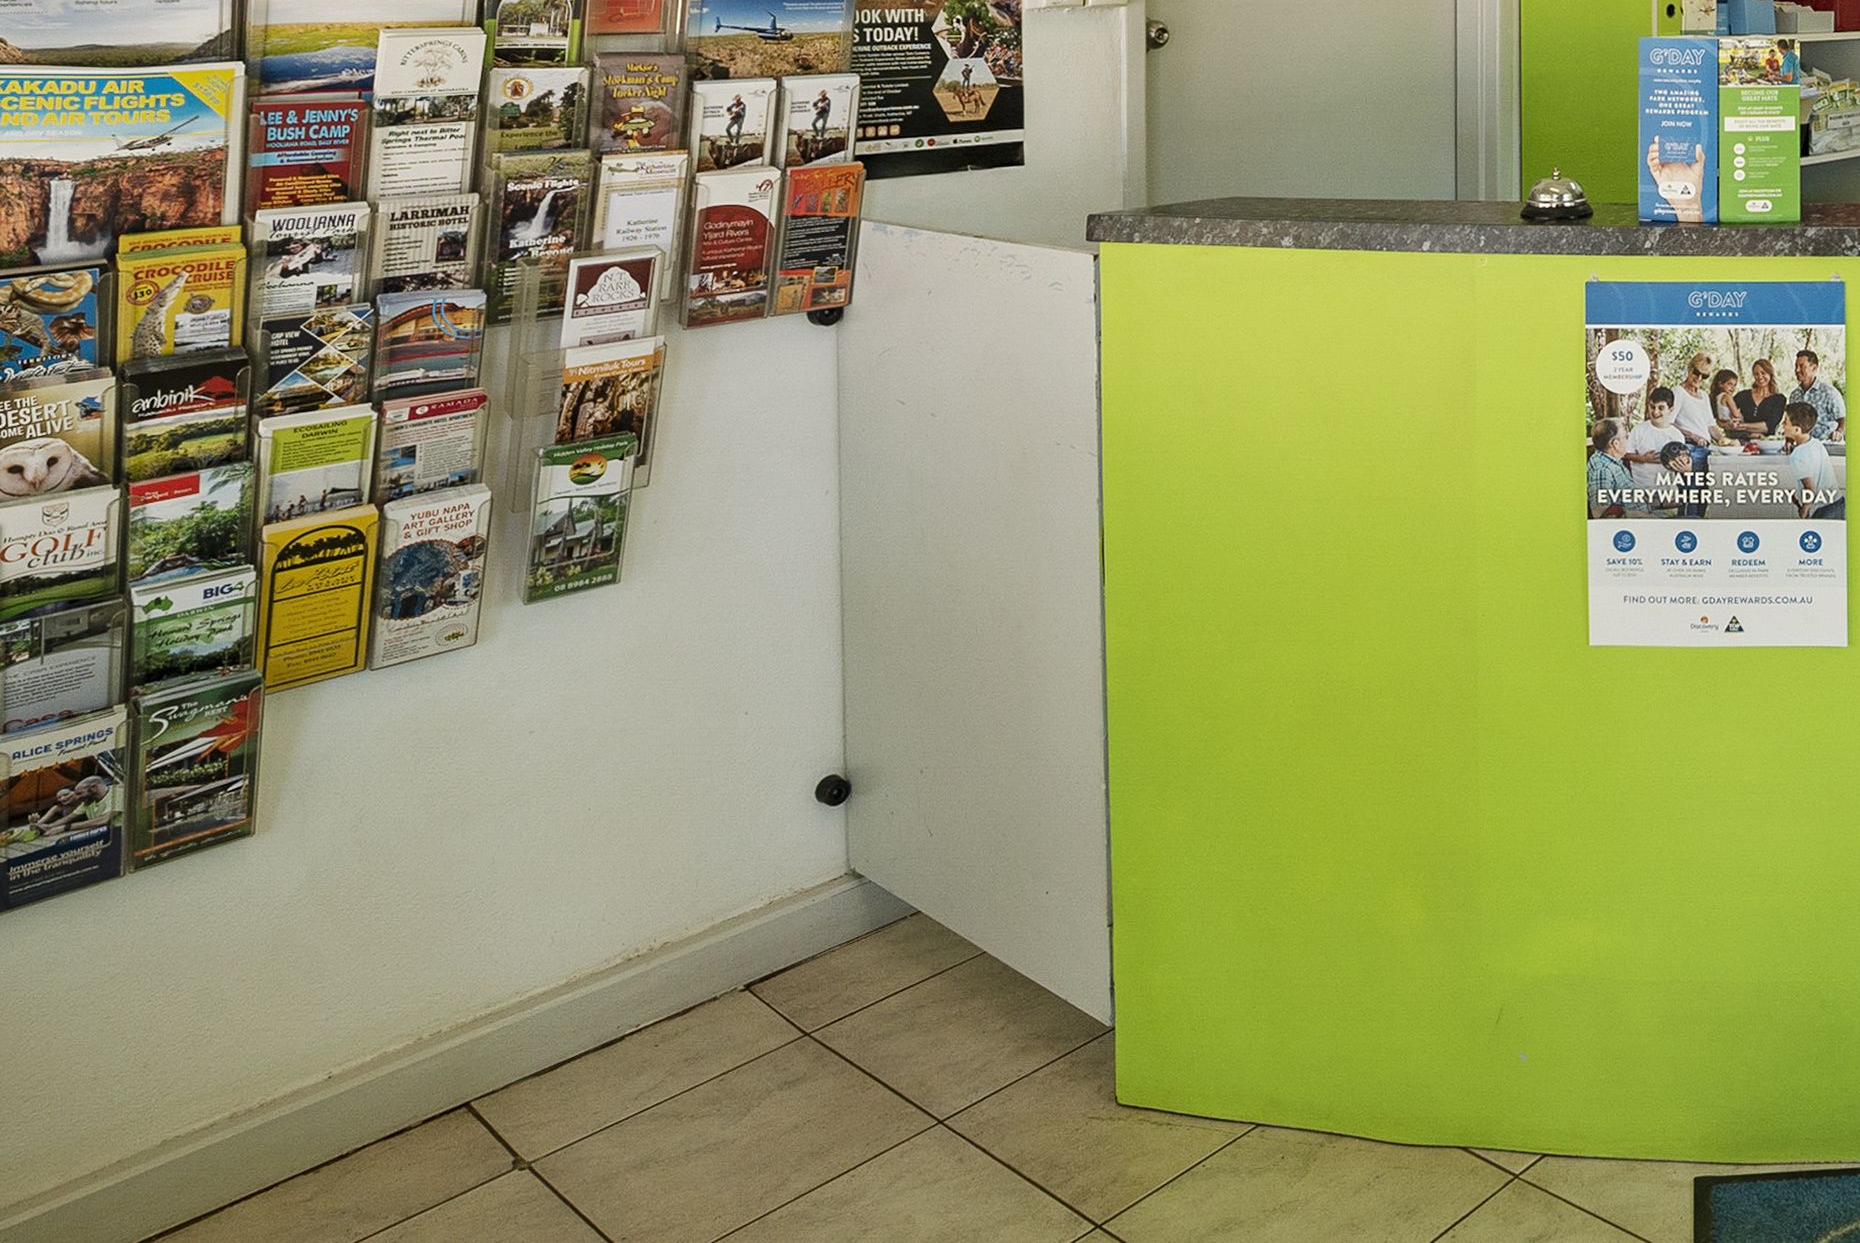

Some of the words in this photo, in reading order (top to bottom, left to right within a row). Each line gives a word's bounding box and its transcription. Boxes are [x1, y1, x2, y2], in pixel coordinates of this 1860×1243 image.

[1650, 48, 1705, 65] G'DAY
[260, 112, 282, 126] LEE
[286, 111, 298, 124] &
[302, 109, 358, 123] JENNY'S
[267, 128, 305, 141] BUSH
[308, 125, 350, 139] CAMP
[507, 181, 542, 192] Scenic
[545, 179, 579, 188] Flights
[390, 206, 470, 222] LARRIMAH
[272, 214, 355, 231] WOOLIANNA
[390, 221, 434, 231] HISTORIC
[438, 217, 469, 226] HOTEL
[509, 235, 566, 248] Katherine
[134, 261, 235, 280] CROCODILE
[185, 271, 235, 284] CRUISE
[1688, 290, 1747, 308] G'DAY
[1611, 350, 1634, 362] $50
[578, 361, 619, 376] Nitmiluk
[621, 358, 646, 368] Tours
[132, 385, 215, 414] anbinik
[430, 397, 478, 410] RAMADA
[294, 420, 348, 433] ECOSAILING
[302, 429, 338, 439] DARWIN
[1656, 471, 1716, 486] MATES
[1722, 472, 1778, 486] RATES
[1597, 489, 1731, 507] EVERYWHERE,
[1736, 489, 1795, 504] EVERY
[1801, 489, 1837, 504] DAY
[410, 509, 438, 520] YUBU
[443, 503, 470, 513] NAPA
[403, 520, 421, 531] ART
[428, 510, 475, 526] GALLERY
[416, 527, 440, 537] GIFT
[444, 519, 473, 531] SHOP
[1661, 558, 1678, 566] STAY
[1681, 558, 1686, 566] &
[1688, 558, 1712, 566] EARN
[1732, 558, 1766, 566] REDEEM
[1798, 558, 1823, 566] MORE
[202, 581, 244, 600] BIG4
[1623, 596, 1646, 604] FIND
[1648, 596, 1668, 604] OUT
[1702, 597, 1813, 605] GDAYREWARDS.COM.AU
[12, 742, 53, 760] ALICE
[55, 727, 114, 748] SPRINGS
